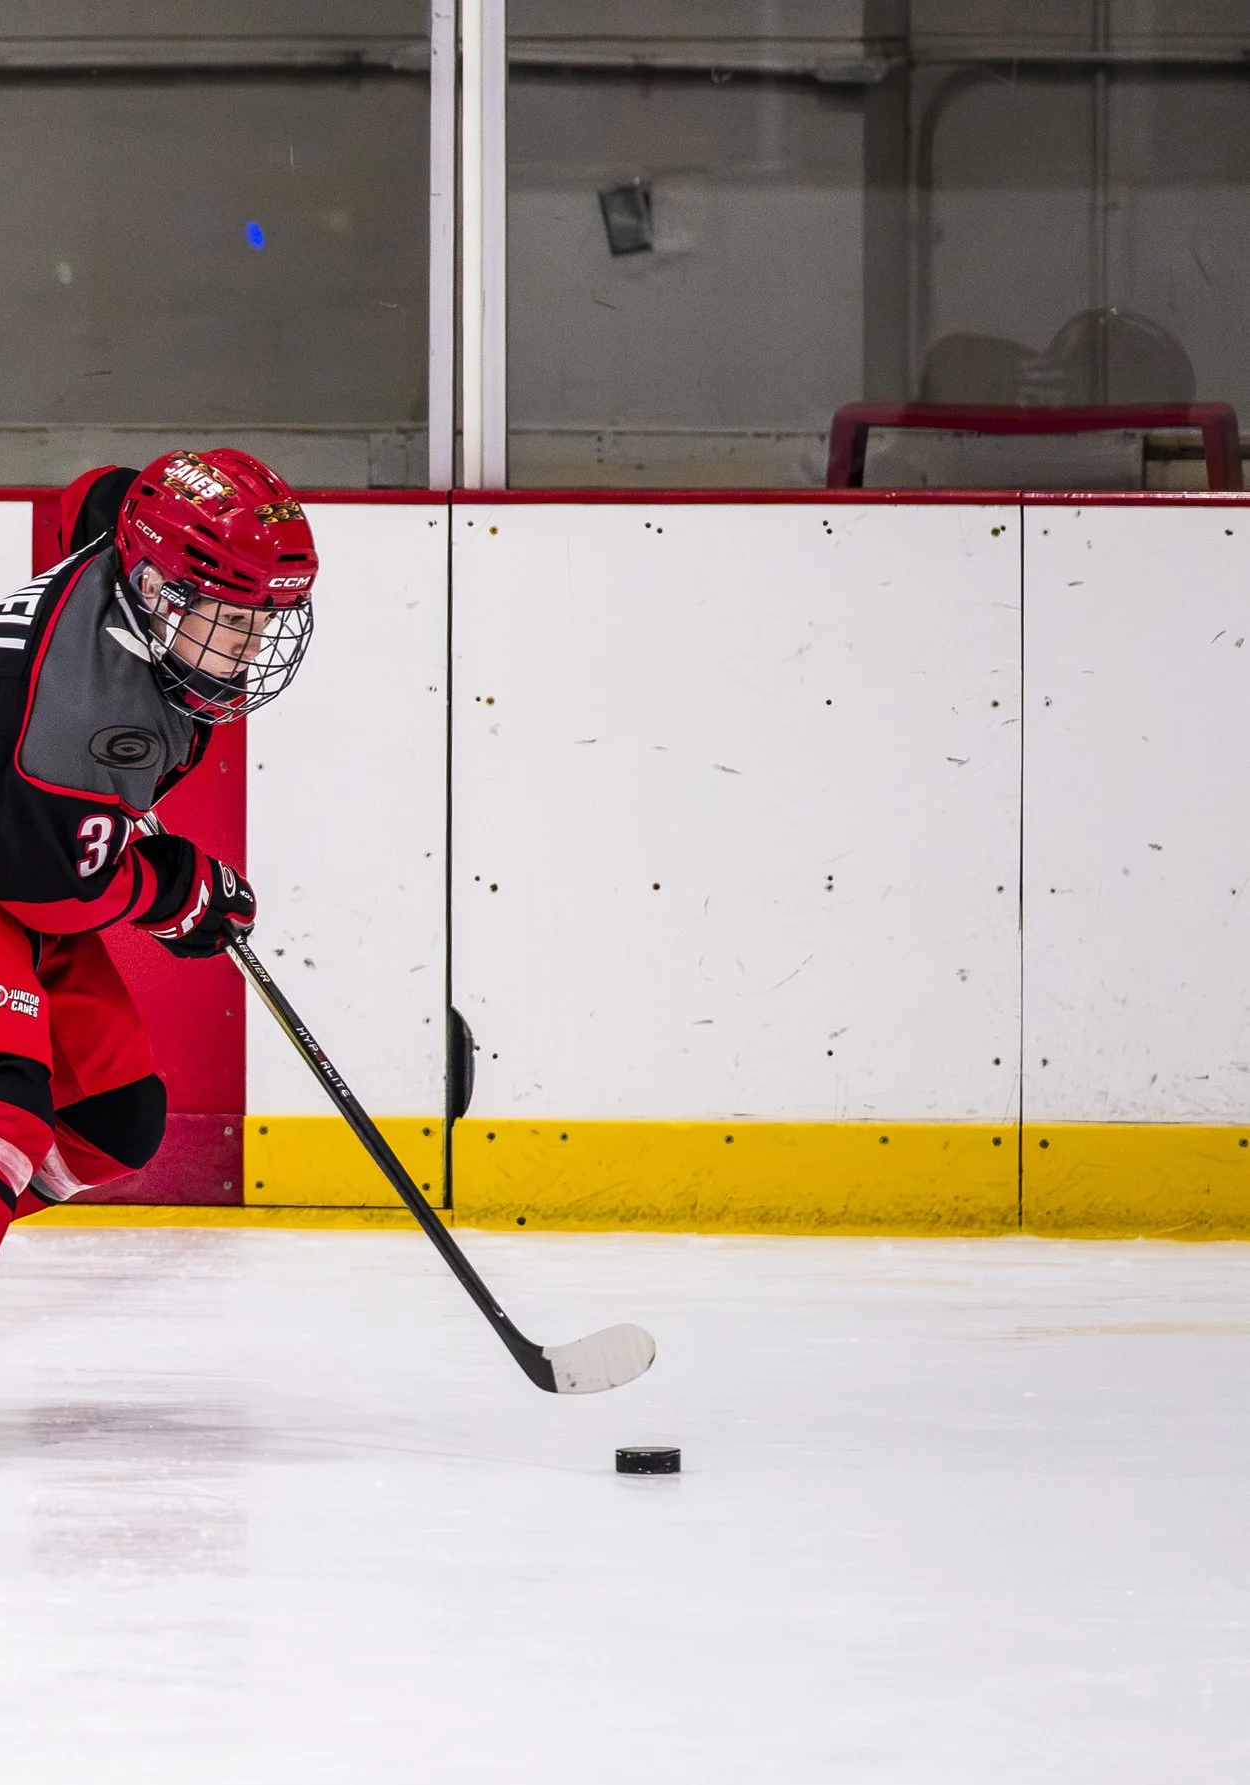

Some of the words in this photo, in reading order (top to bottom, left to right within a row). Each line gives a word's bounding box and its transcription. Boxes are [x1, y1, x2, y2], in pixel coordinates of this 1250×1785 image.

[164, 459, 224, 499] CANES
[135, 519, 163, 544] CCM
[268, 576, 311, 588] CCM
[160, 589, 186, 607] CCM
[238, 943, 271, 983] BAUER
[8, 988, 40, 1006] JUNIOR
[11, 1000, 39, 1018] CANES
